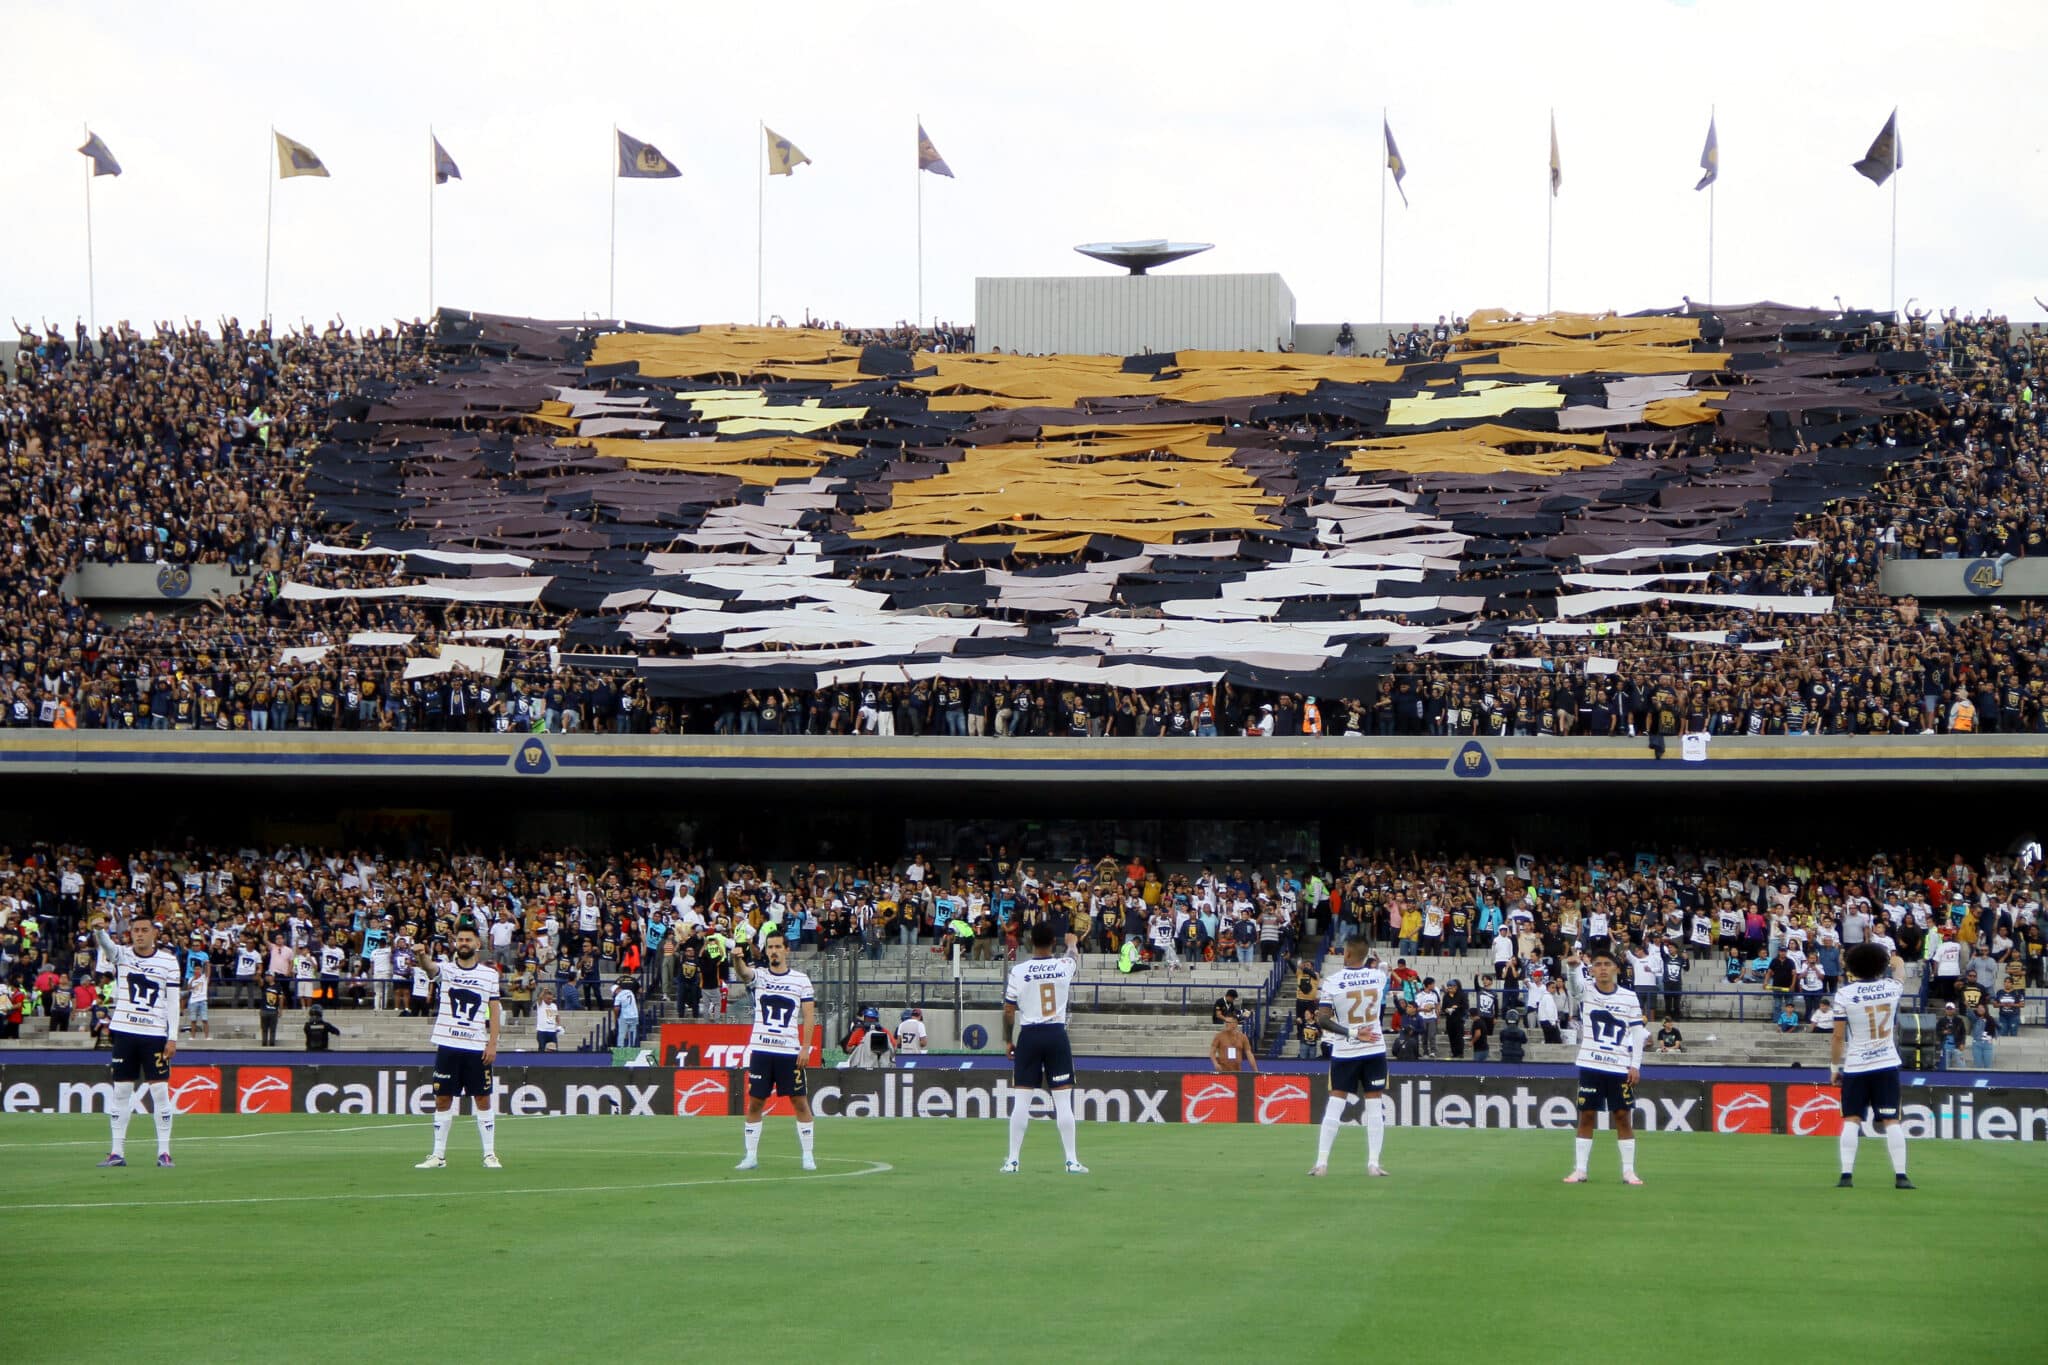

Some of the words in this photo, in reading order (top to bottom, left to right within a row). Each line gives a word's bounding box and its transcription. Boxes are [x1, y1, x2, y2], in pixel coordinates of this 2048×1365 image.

[160, 569, 189, 590] 29
[1971, 566, 1993, 588] 41
[1028, 964, 1057, 973] telcel
[1857, 984, 1886, 994] telcel
[1040, 983, 1057, 1017] 8
[1346, 988, 1379, 1025] 22
[1864, 1004, 1892, 1040] 12
[902, 1033, 916, 1044] 57
[793, 1069, 802, 1084] 2
[811, 1073, 1168, 1124] calientemx
